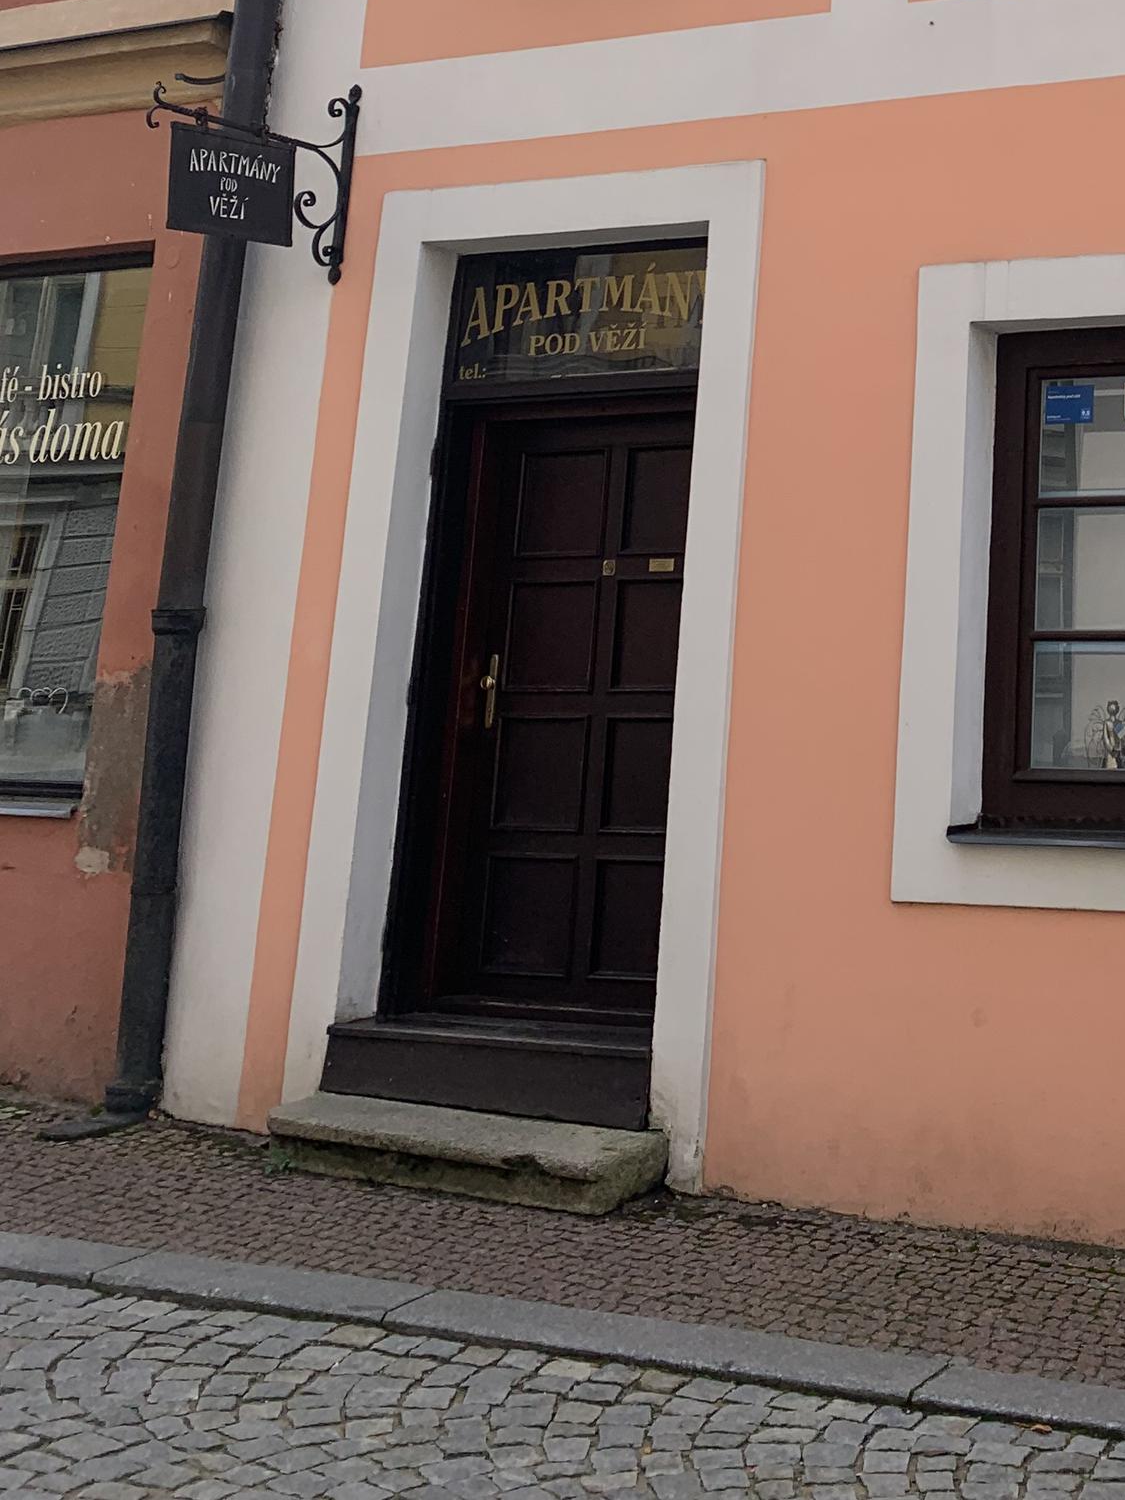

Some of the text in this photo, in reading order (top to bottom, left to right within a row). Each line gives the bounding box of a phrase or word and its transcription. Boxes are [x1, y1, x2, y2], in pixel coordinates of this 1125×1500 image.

[189, 148, 281, 184] APARTMÁNY
[220, 176, 238, 192] POD
[209, 193, 250, 220] VĚŽÍ
[528, 321, 649, 357] POD VĚŽÍ
[36, 363, 103, 401] bistro
[458, 363, 488, 381] tel.:
[28, 408, 125, 464] doma
